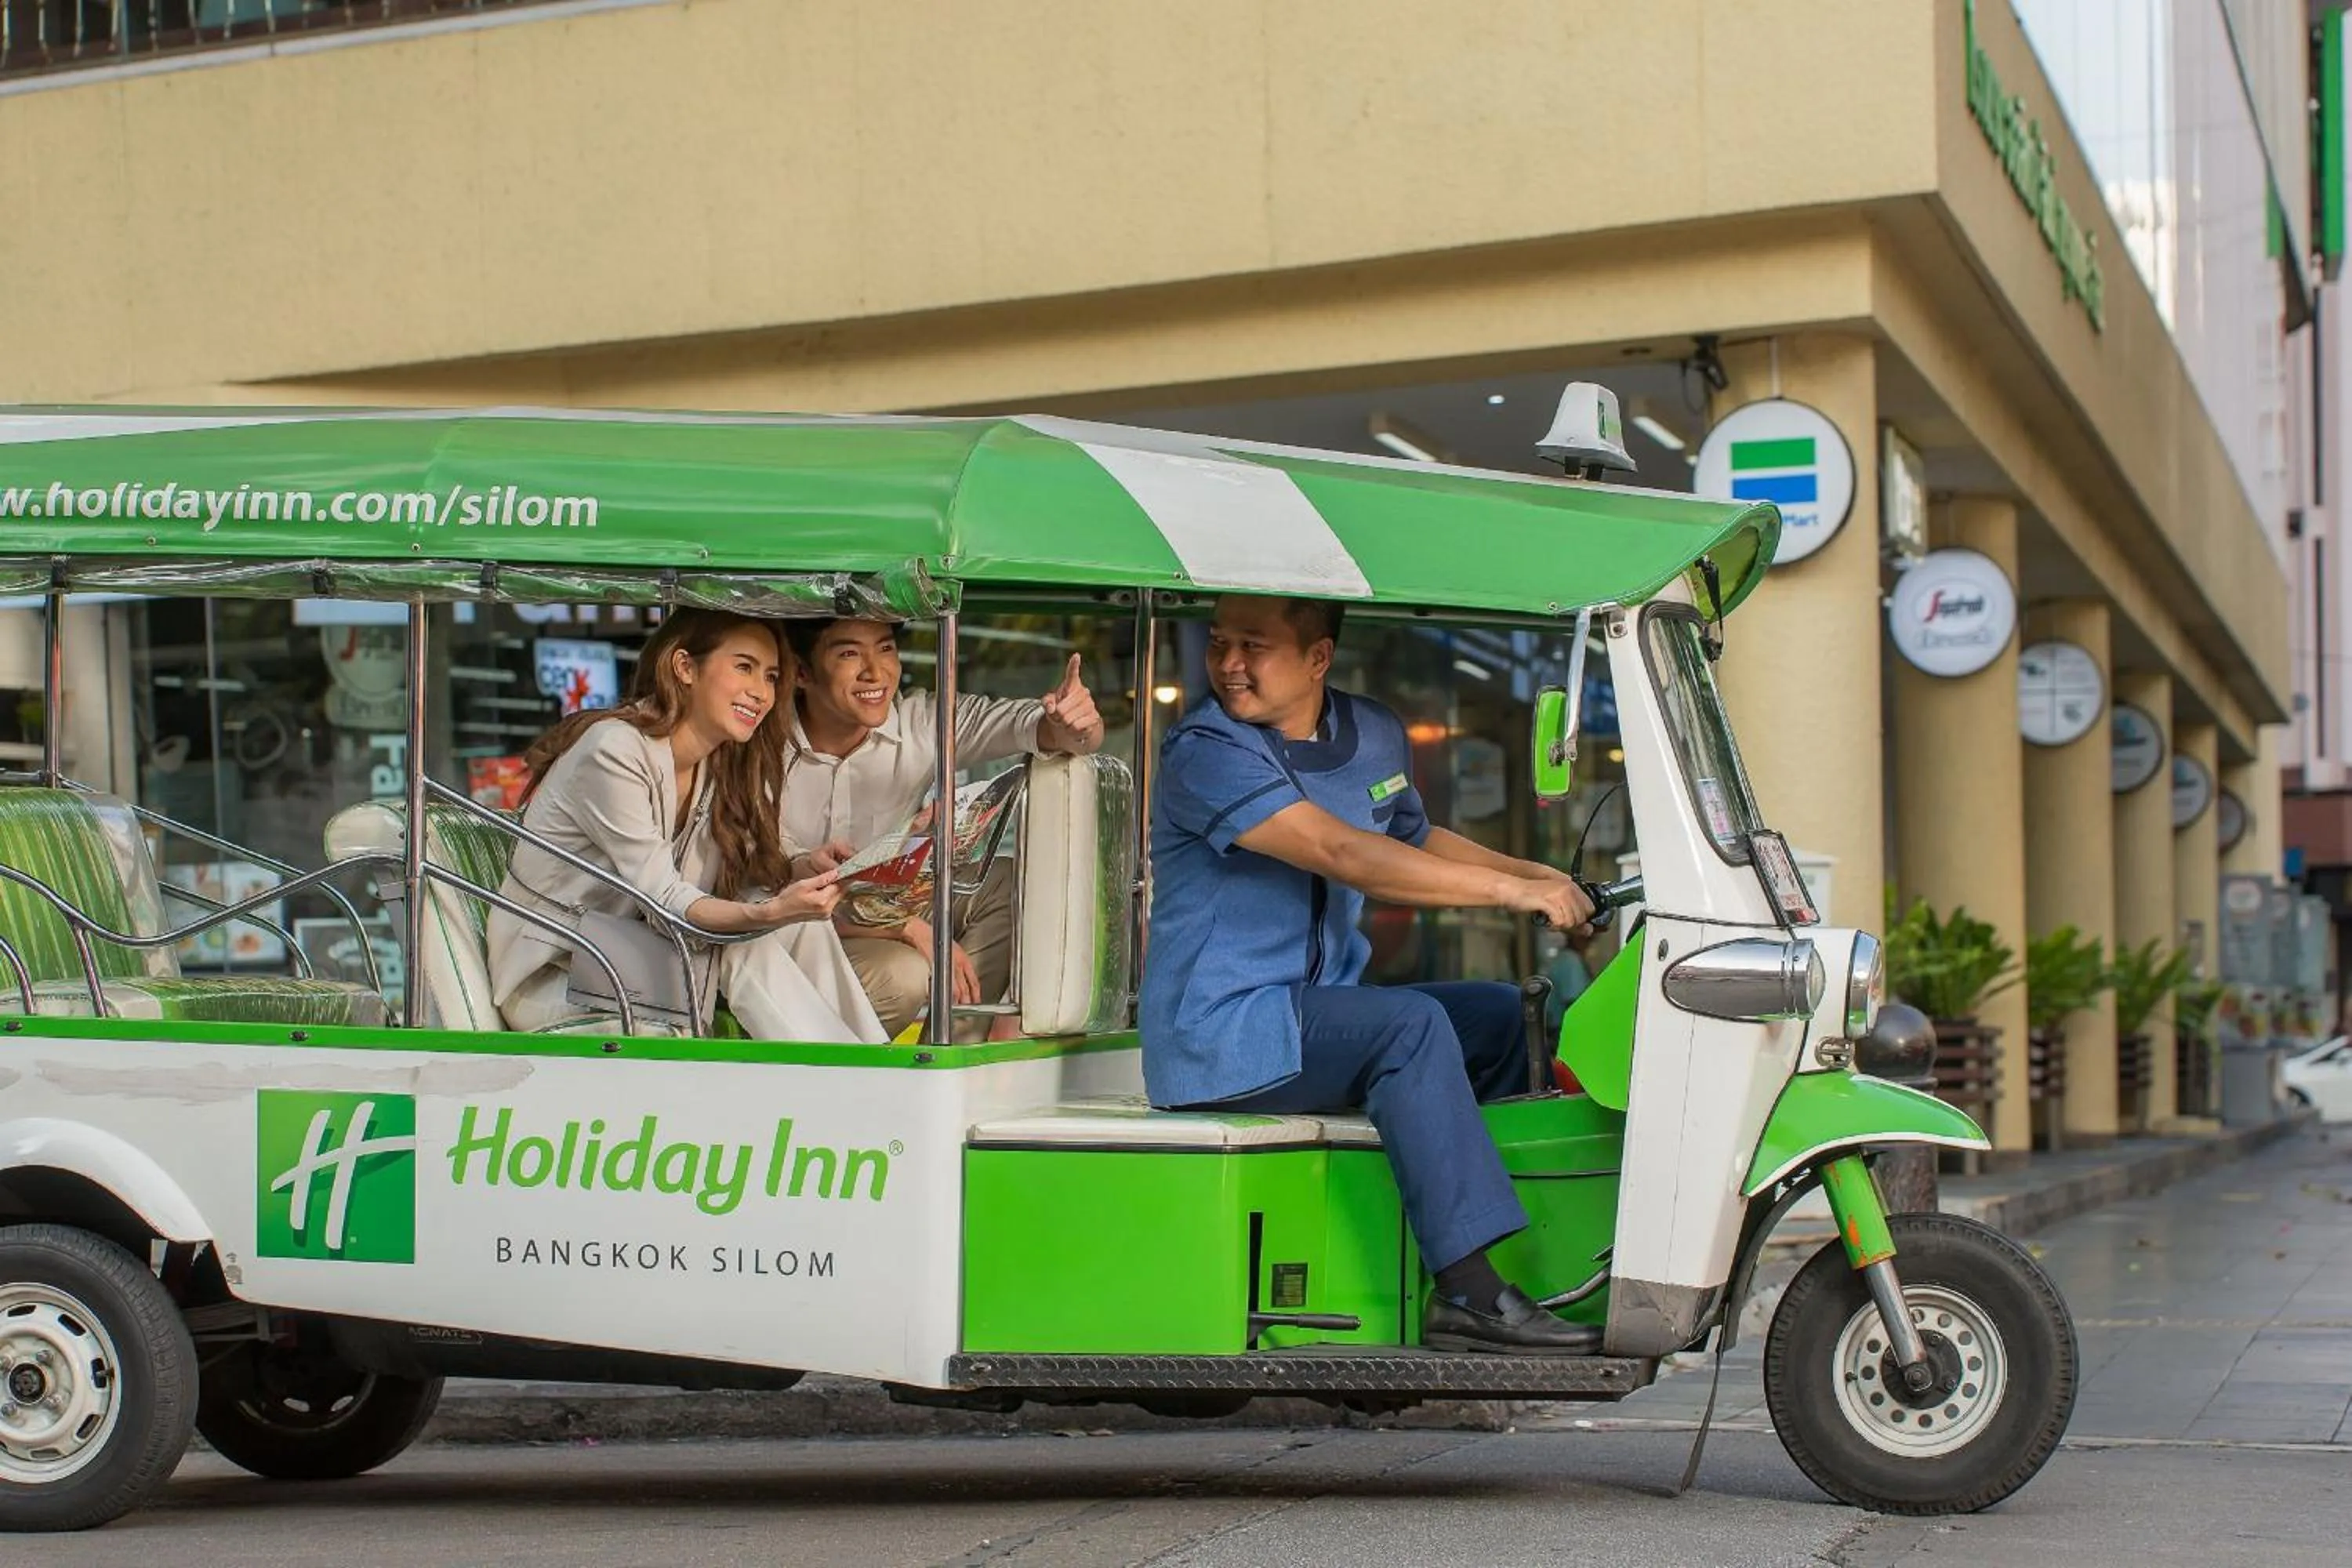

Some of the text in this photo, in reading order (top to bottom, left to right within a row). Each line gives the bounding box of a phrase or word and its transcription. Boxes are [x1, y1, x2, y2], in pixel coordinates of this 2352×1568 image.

[447, 1106, 753, 1215] Holiday
[495, 1236, 833, 1277] BANGKOK SILOM
